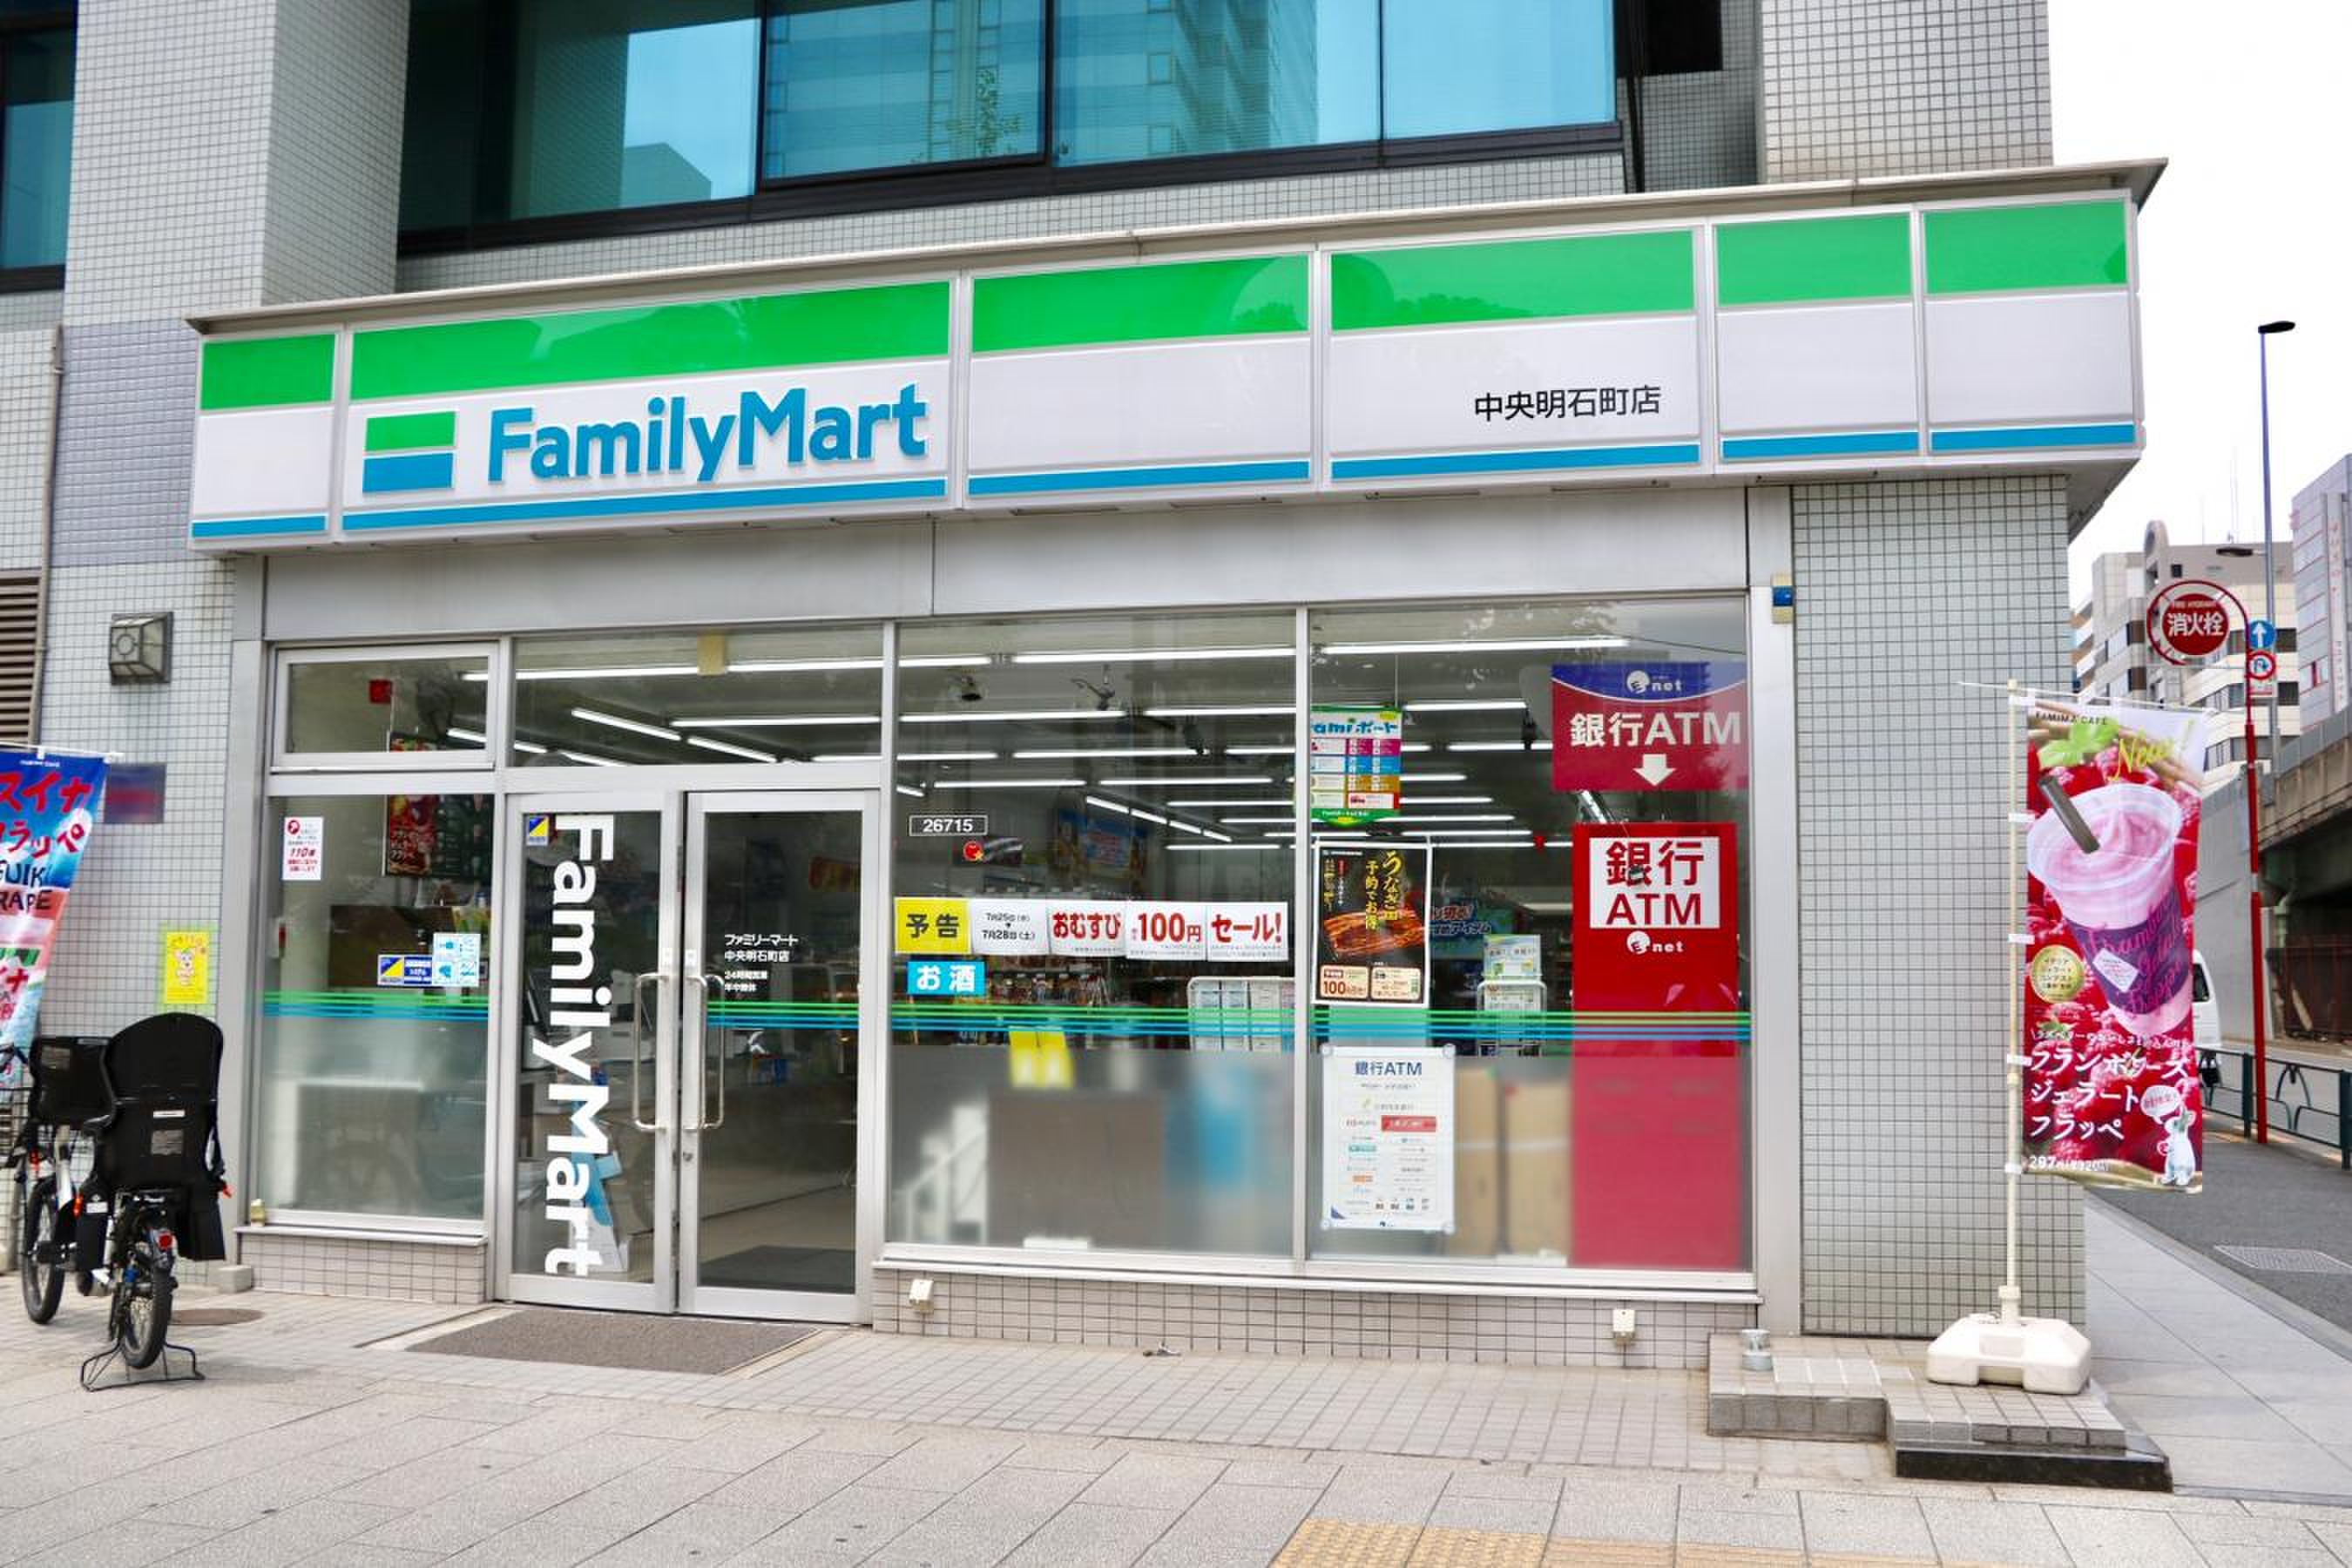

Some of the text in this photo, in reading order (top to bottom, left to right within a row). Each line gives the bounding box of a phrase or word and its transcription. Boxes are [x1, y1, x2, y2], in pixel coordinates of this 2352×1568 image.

[1474, 384, 1662, 422] 中央明石町店
[488, 382, 928, 483] FamilyMart
[2166, 611, 2224, 639] 消火栓
[1569, 710, 1741, 748] 銀行ATM
[923, 819, 974, 833] 26715
[1605, 840, 1705, 887] 銀行
[1606, 892, 1701, 925] ATM
[906, 913, 960, 939] 予告
[1051, 912, 1121, 940] おむすび
[724, 934, 799, 947] ファミリーマート
[916, 964, 977, 991] お酒
[532, 814, 614, 1276] FamilyMart
[1355, 1061, 1423, 1076] 銀行ATM
[2031, 1079, 2139, 1112] ジェラート
[2031, 1114, 2125, 1140] フラッペ
